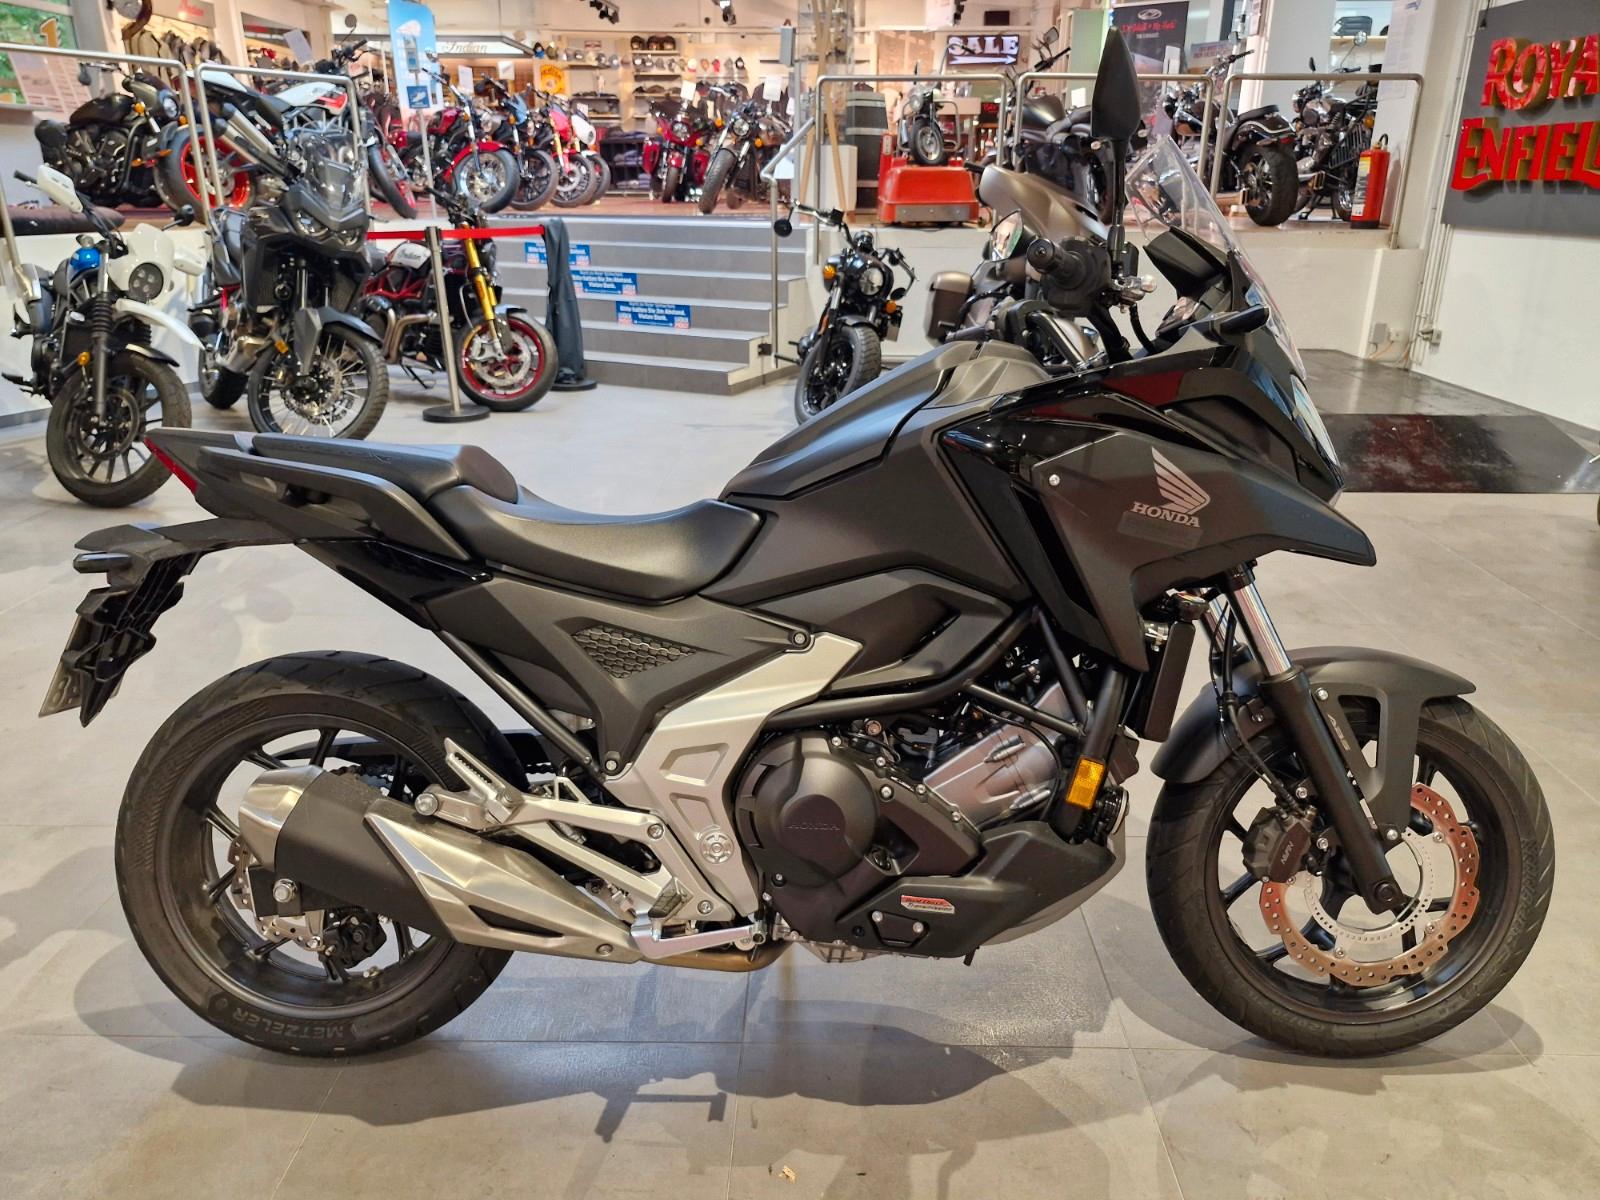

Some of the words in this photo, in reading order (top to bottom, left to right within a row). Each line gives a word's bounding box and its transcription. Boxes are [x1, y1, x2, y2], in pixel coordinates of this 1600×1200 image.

[948, 35, 1019, 56] SALE
[1450, 117, 1600, 192] ENFIEL
[1131, 501, 1201, 528] HONDA
[232, 1007, 344, 1038] METZELER
